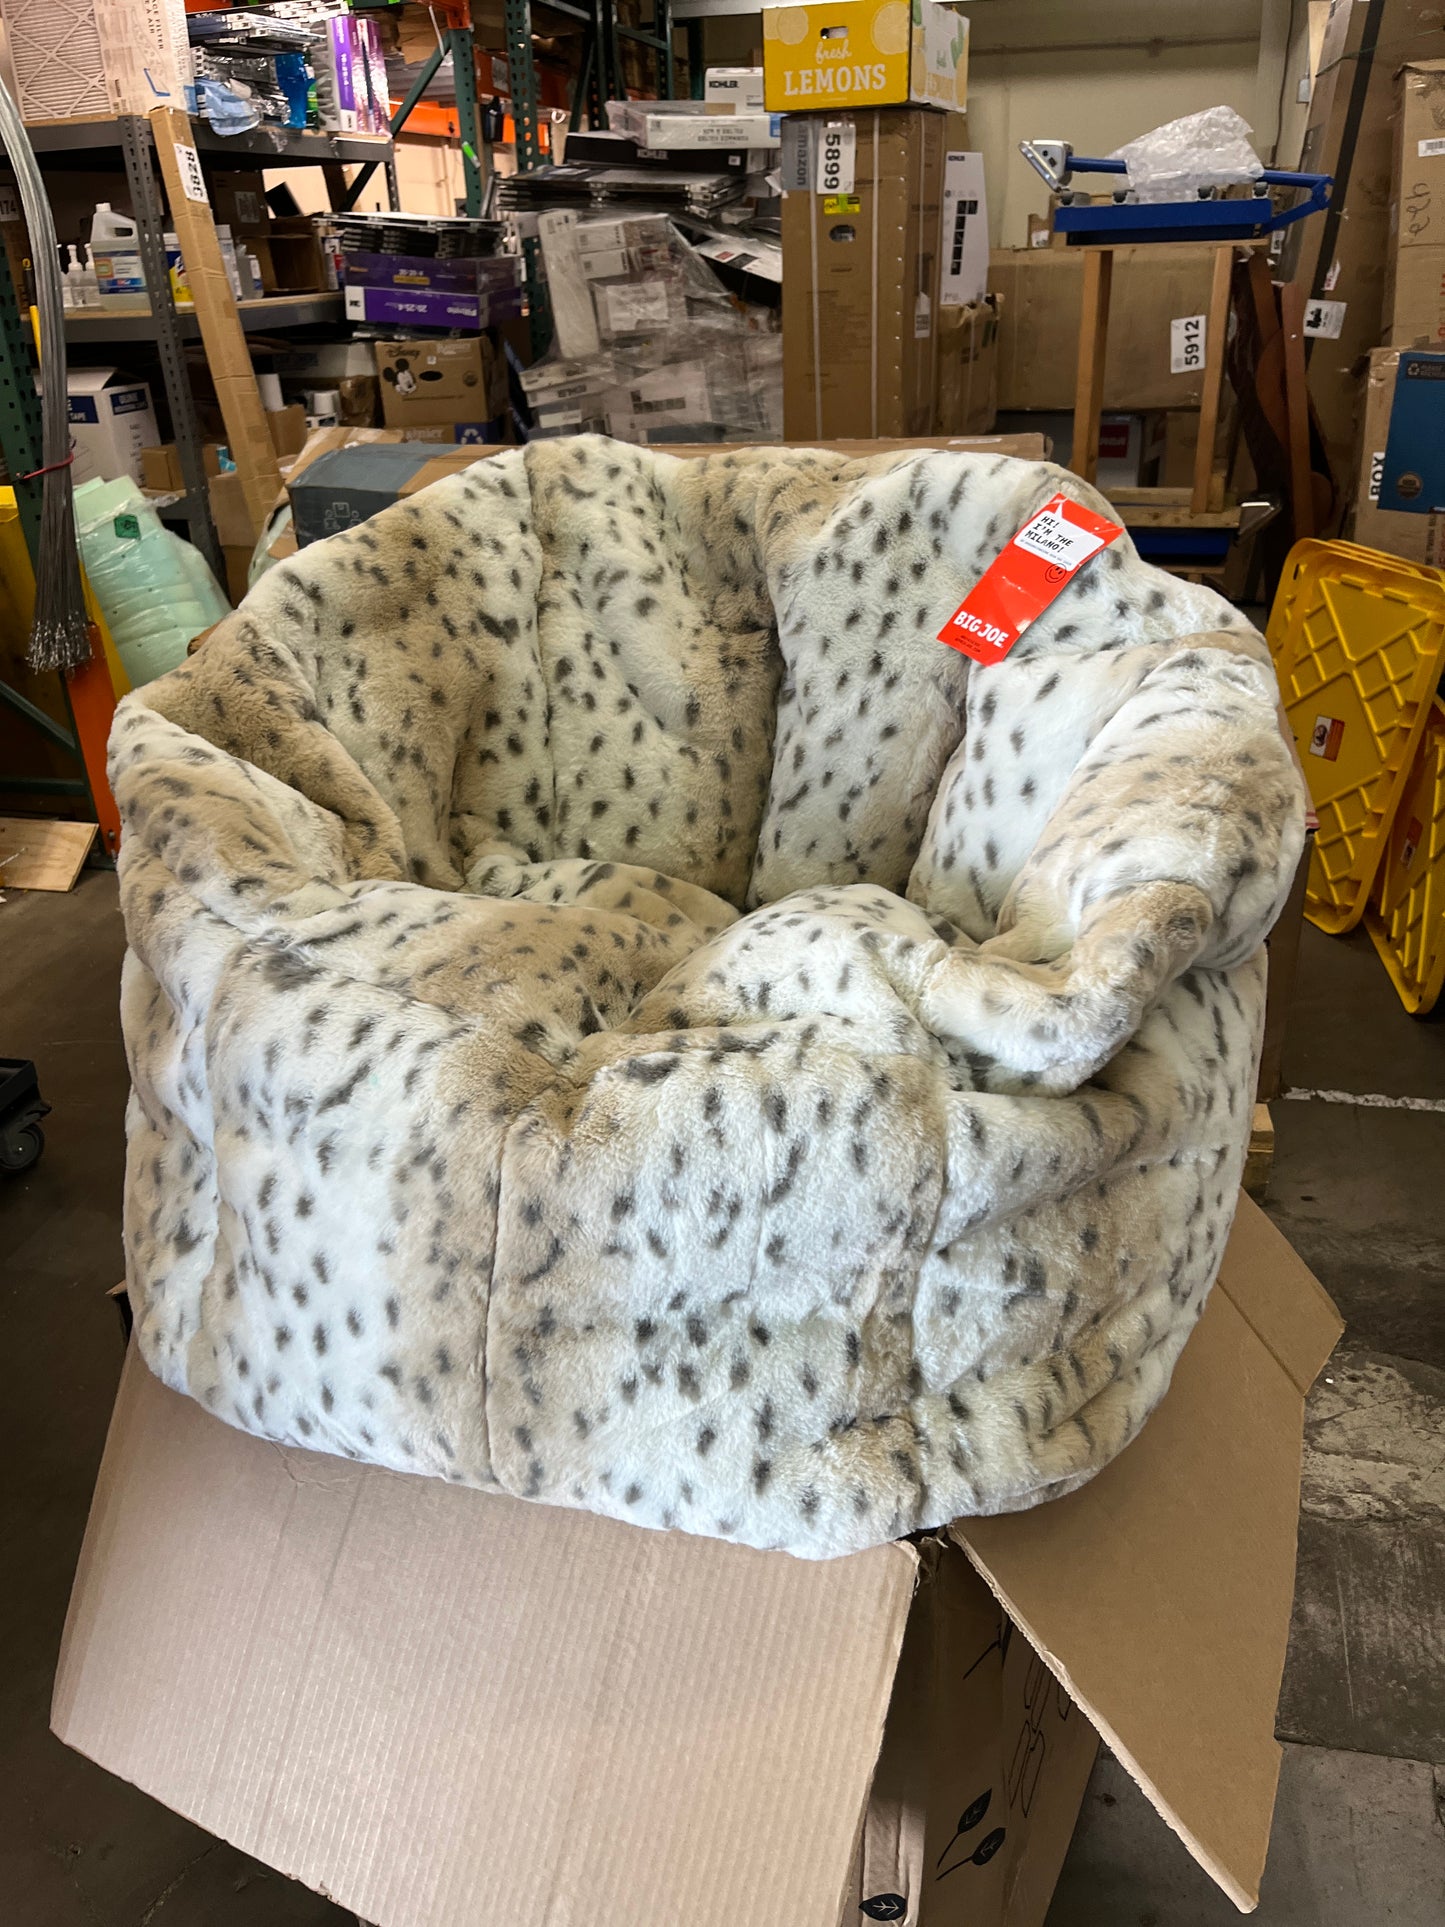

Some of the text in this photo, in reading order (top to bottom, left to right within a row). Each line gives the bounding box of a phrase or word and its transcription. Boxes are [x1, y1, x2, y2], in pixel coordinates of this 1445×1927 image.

[155, 19, 164, 50] FILTER
[815, 39, 852, 64] fresh
[709, 80, 740, 89] KOHLER
[784, 63, 887, 96] LEMONS
[797, 124, 809, 186] amazon
[824, 133, 841, 190] 5899
[1184, 319, 1200, 366] 5912
[1032, 523, 1074, 547] I'M THE
[1041, 515, 1060, 529] HI!
[1024, 530, 1065, 553] MILANO!
[953, 610, 983, 632] BIG
[976, 623, 1009, 649] JOE
